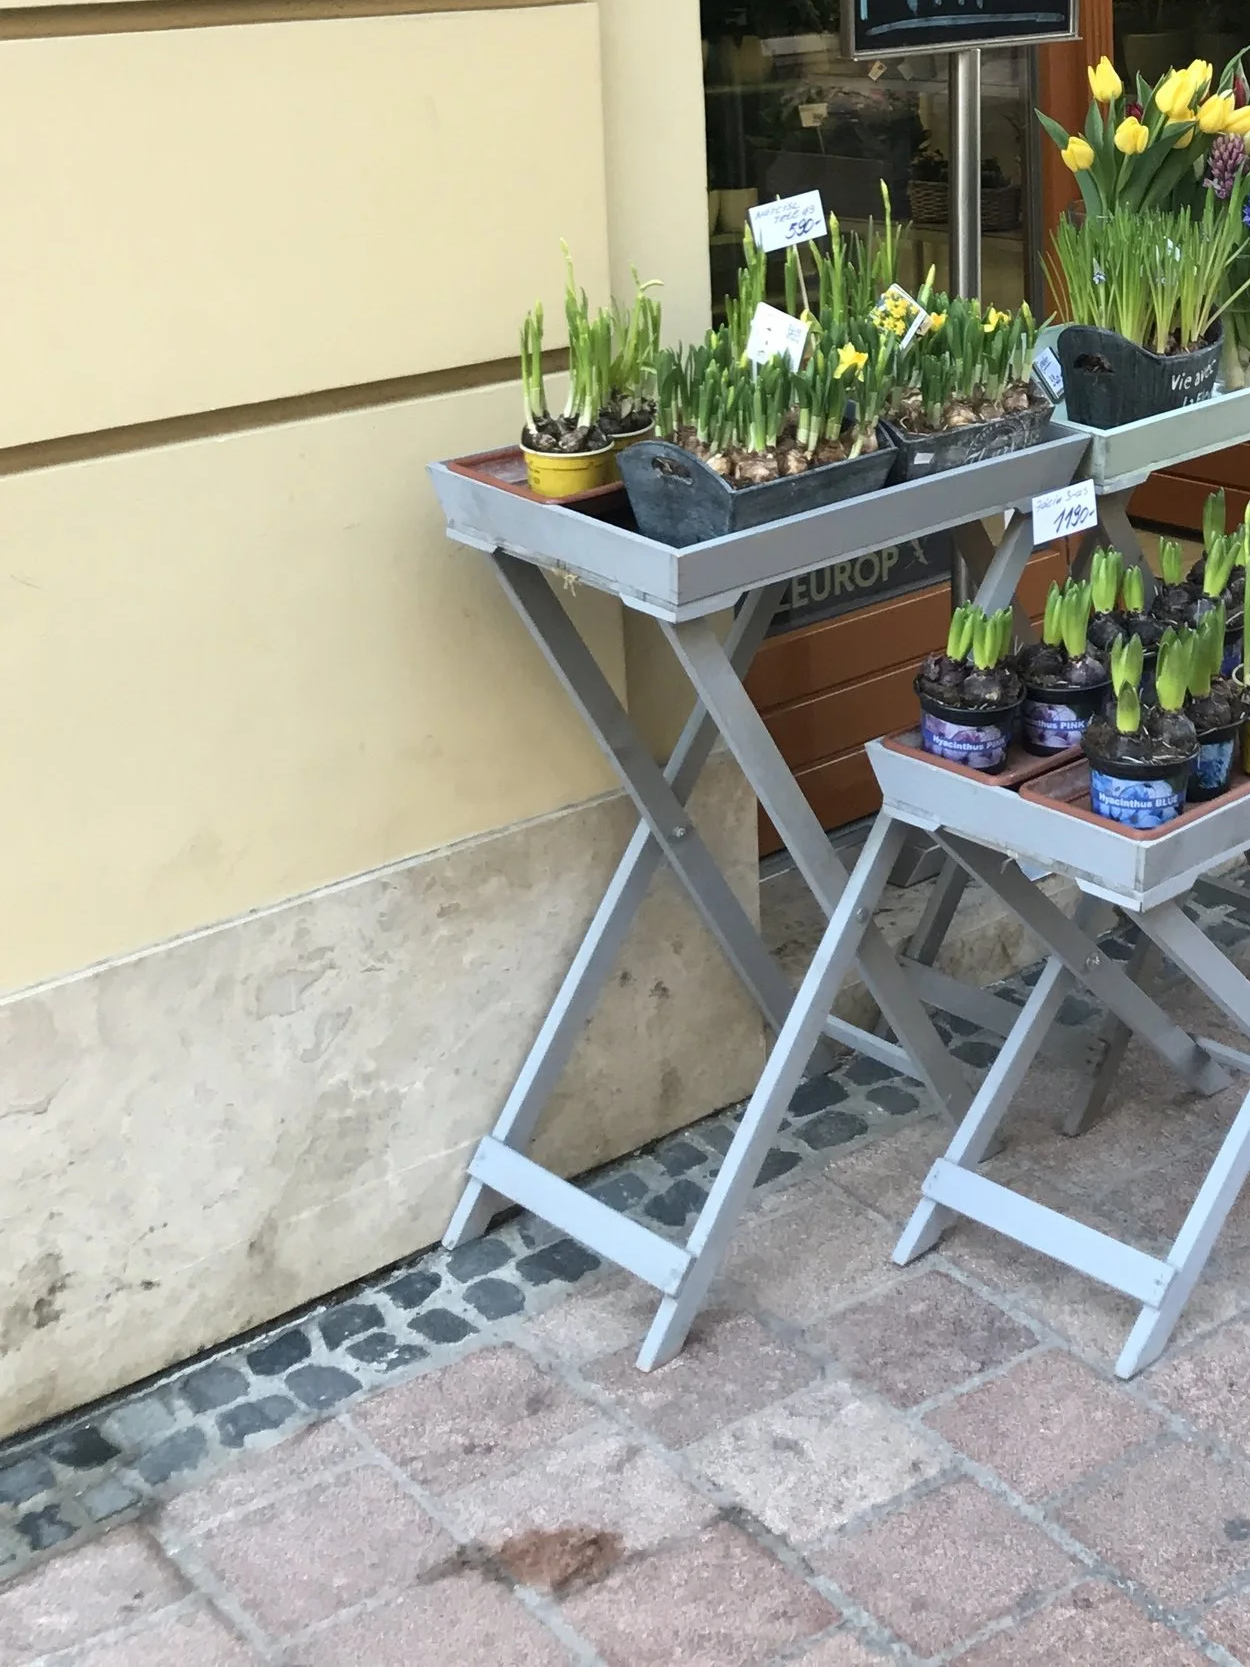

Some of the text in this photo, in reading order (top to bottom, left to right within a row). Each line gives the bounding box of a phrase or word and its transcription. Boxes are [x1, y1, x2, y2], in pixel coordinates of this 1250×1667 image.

[1171, 371, 1193, 391] Vie
[1060, 720, 1085, 729] PINK
[932, 735, 984, 751] Hyacinthus
[1099, 792, 1179, 809] Hyacinthus BLUE
